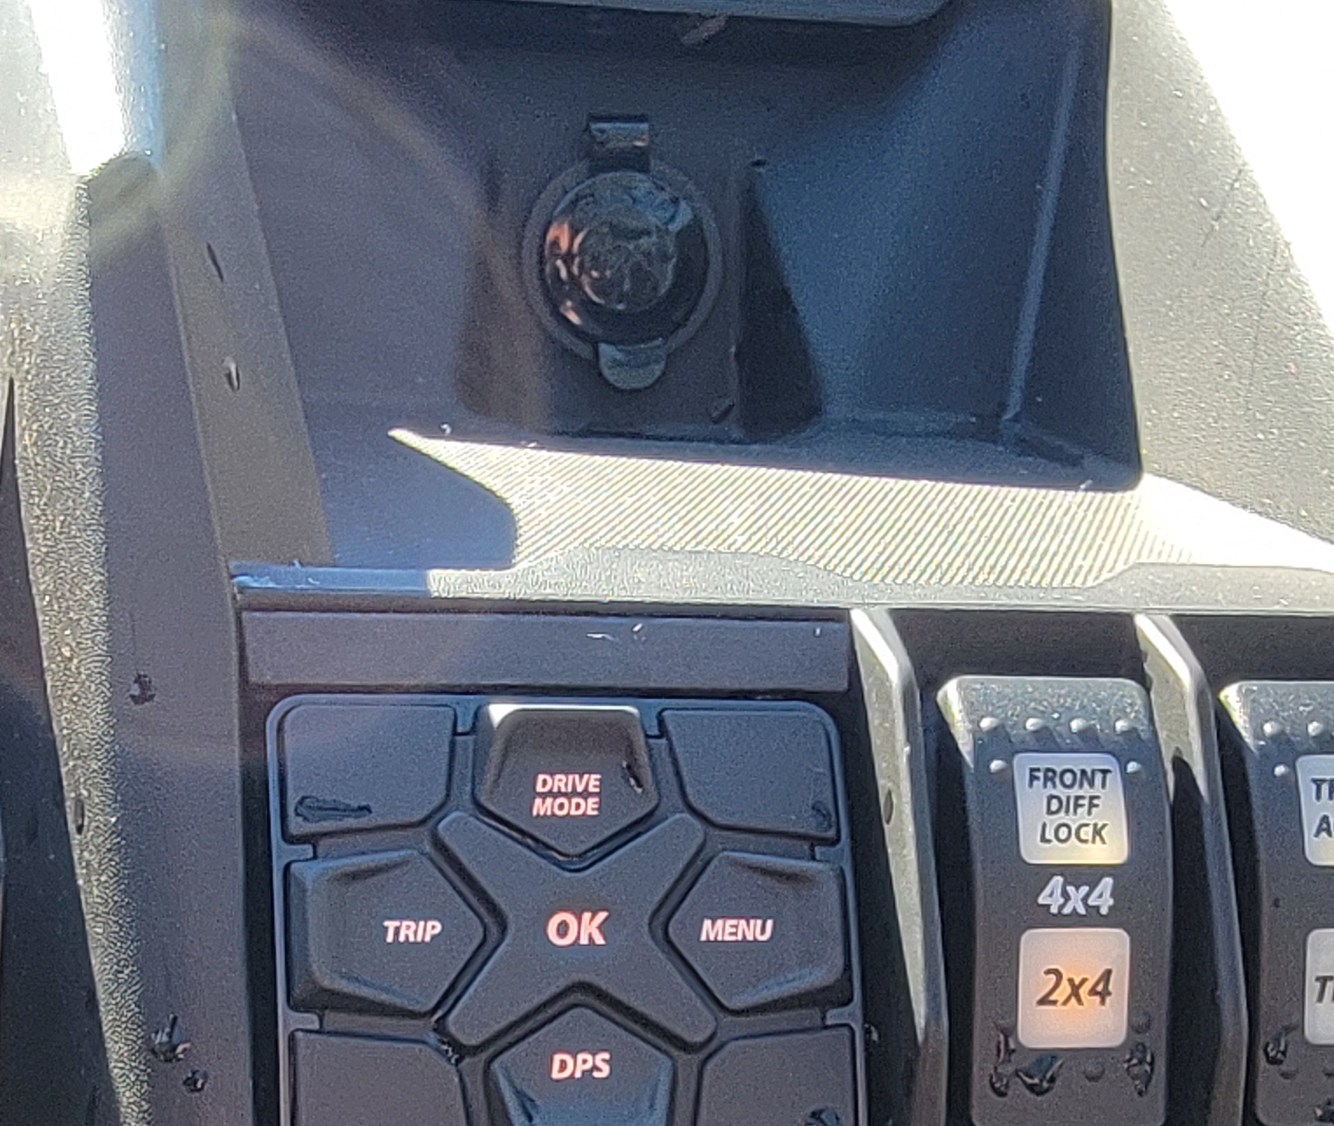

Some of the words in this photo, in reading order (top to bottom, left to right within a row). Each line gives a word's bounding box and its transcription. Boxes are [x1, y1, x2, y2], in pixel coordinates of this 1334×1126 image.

[534, 773, 602, 794] DRIVE
[1027, 767, 1113, 791] FRONT
[532, 796, 600, 817] MODE
[1045, 795, 1101, 818] DIFF
[1039, 822, 1109, 846] LOCK
[1036, 875, 1115, 916] 4x4
[383, 919, 443, 943] TRIP
[546, 911, 609, 946] OK
[699, 918, 774, 943] MENU
[1035, 967, 1114, 1008] 2x4
[550, 1053, 612, 1079] DPS
